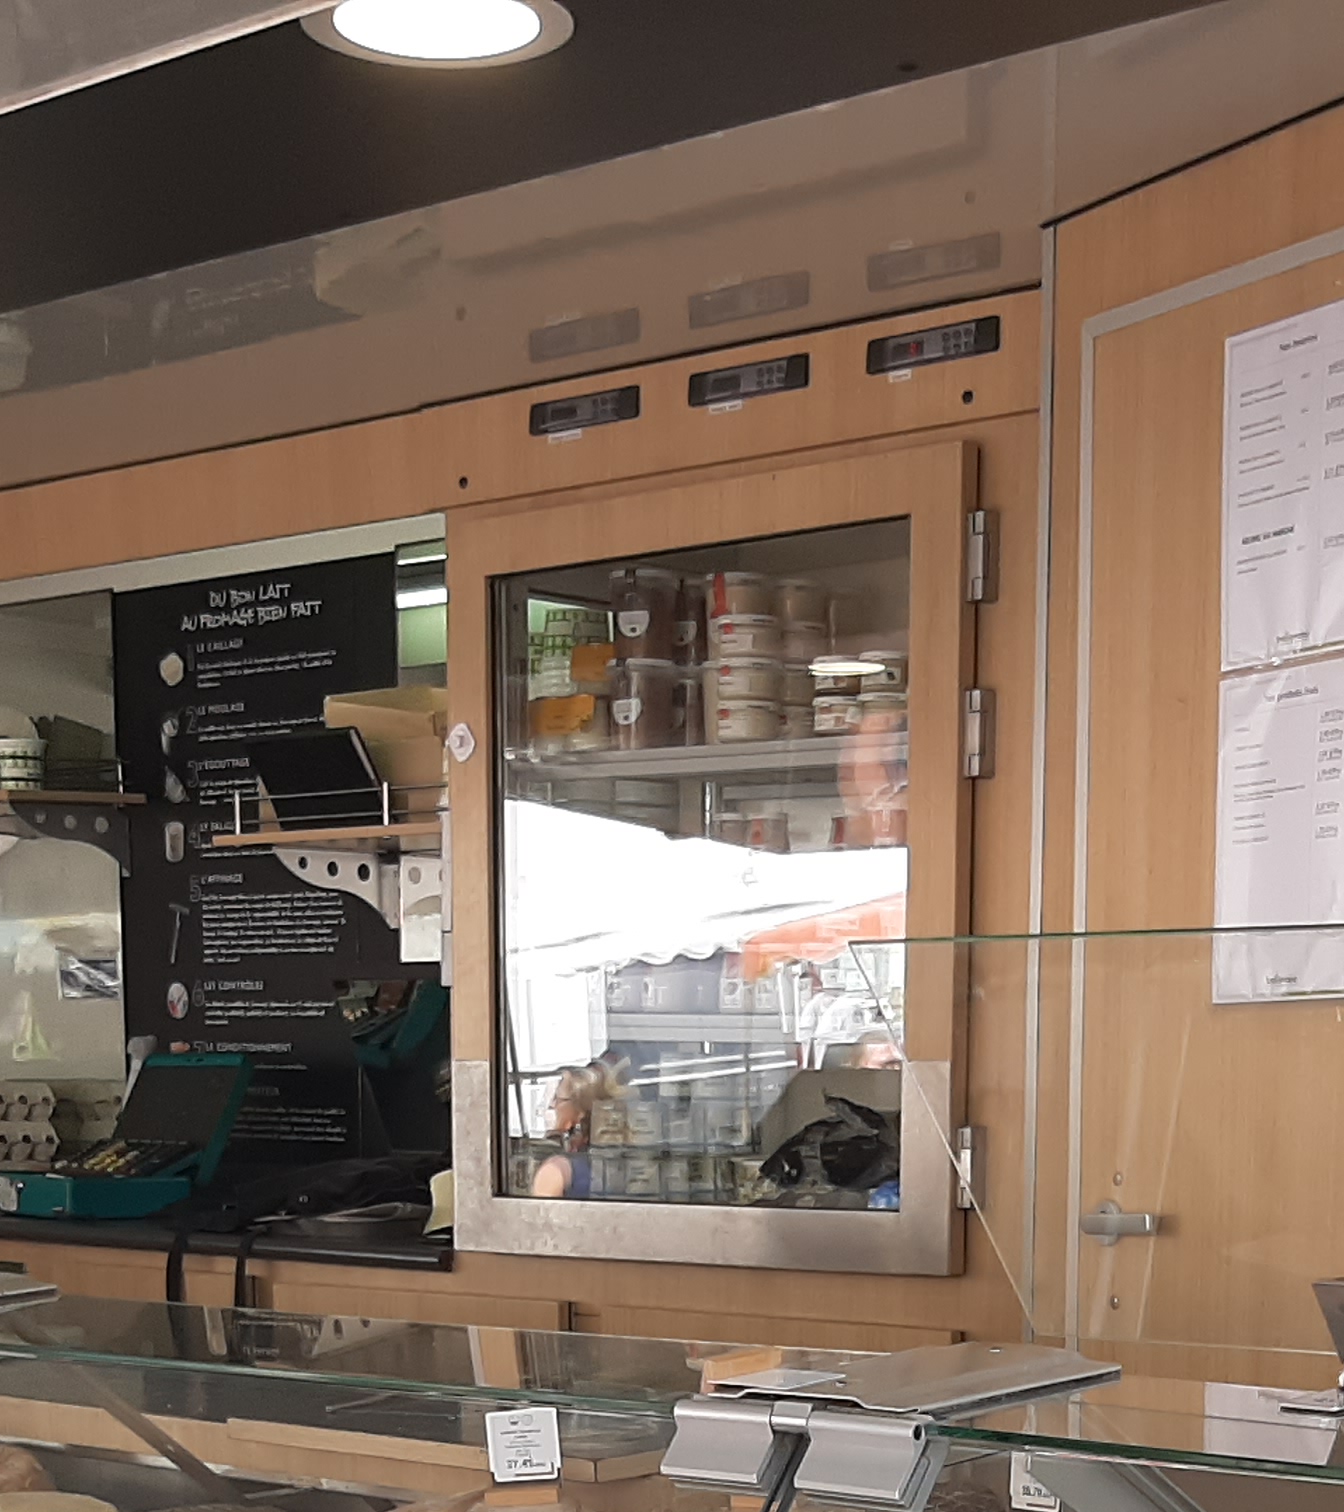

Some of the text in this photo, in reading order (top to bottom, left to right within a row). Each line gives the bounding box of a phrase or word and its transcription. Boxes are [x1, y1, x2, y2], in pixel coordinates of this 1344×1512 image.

[209, 590, 226, 608] DU
[229, 588, 256, 608] BON
[181, 615, 197, 631] AU
[200, 607, 255, 628] FROMAGE
[256, 605, 288, 625] BIEN
